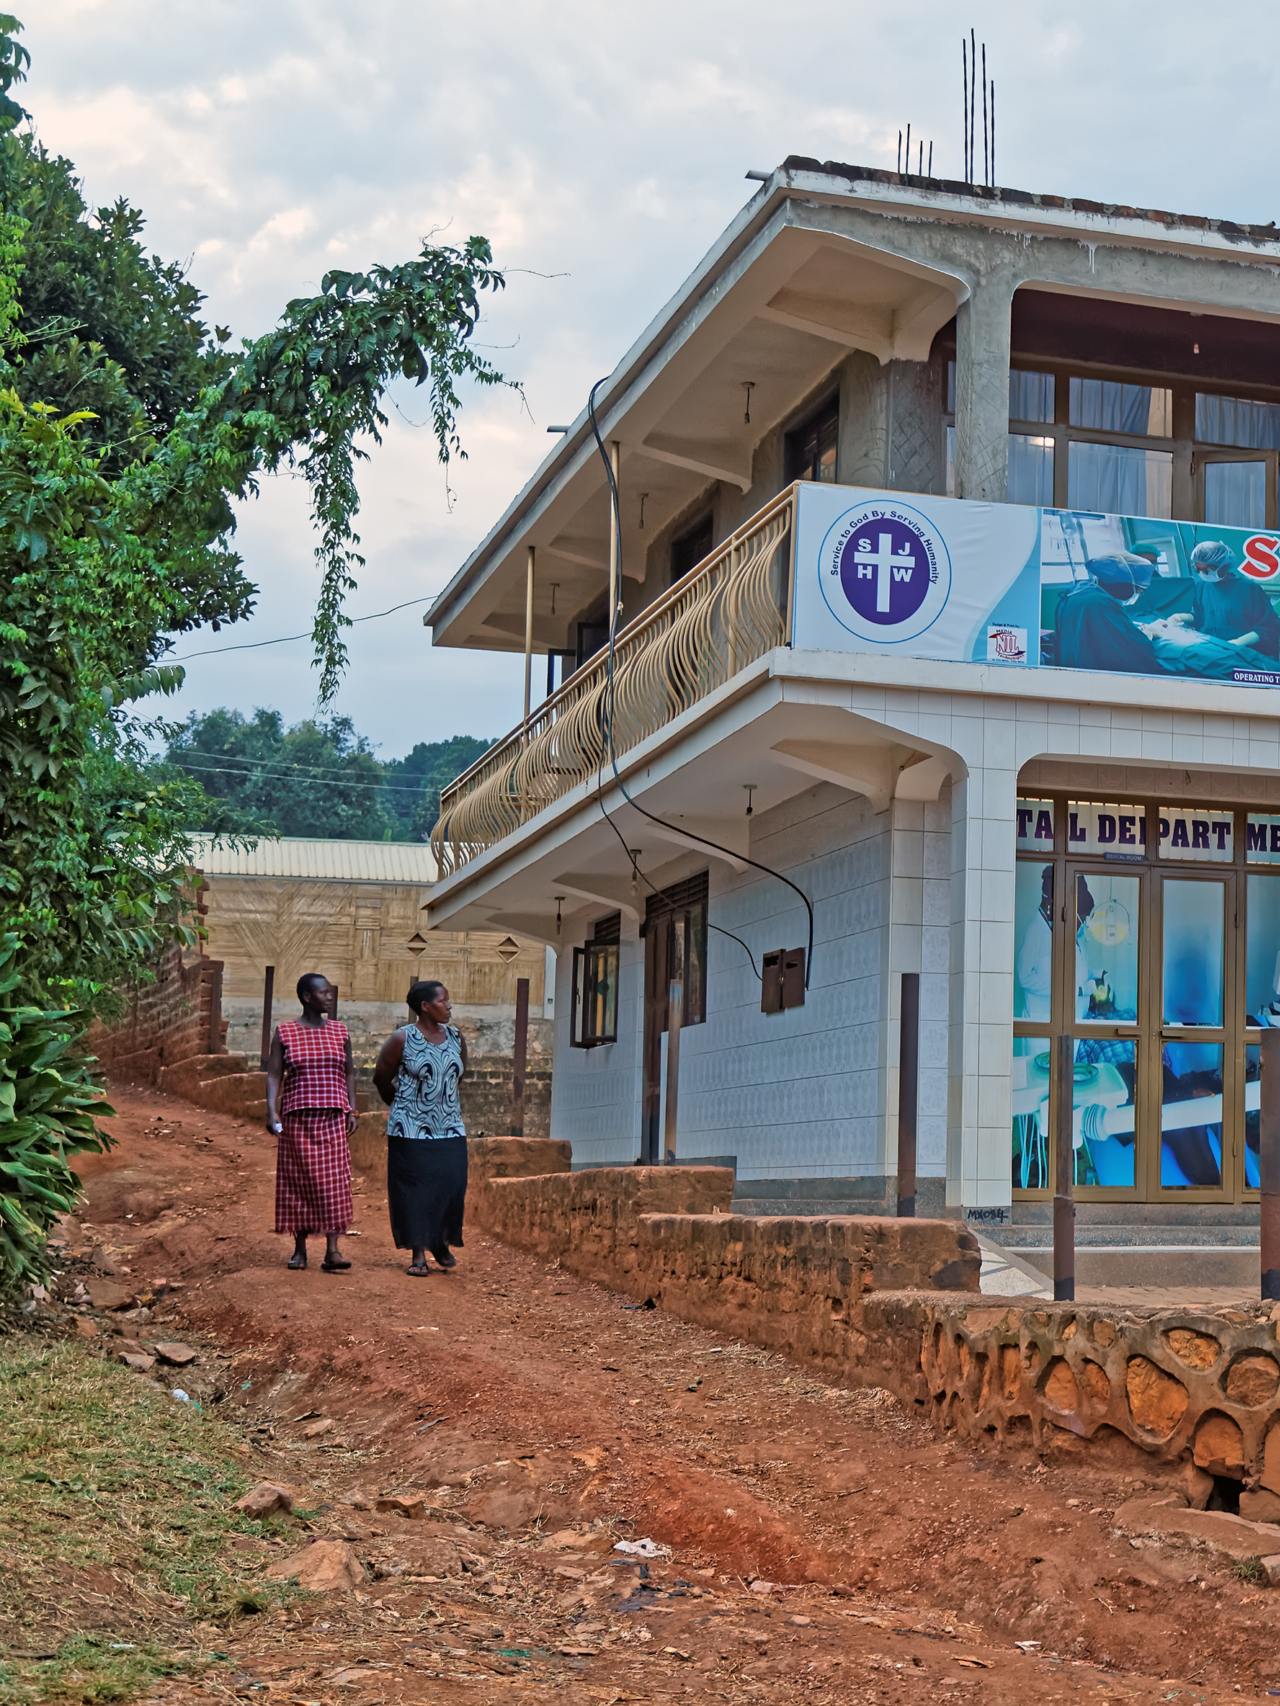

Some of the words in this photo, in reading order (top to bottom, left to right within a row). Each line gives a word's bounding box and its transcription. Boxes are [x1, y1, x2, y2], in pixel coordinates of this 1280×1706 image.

[830, 540, 845, 576] Service
[841, 529, 851, 539] to
[849, 513, 869, 529] God
[871, 510, 886, 519] By
[890, 510, 925, 537] Serving
[923, 539, 939, 584] Humanity
[1234, 672, 1275, 684] OPERATING
